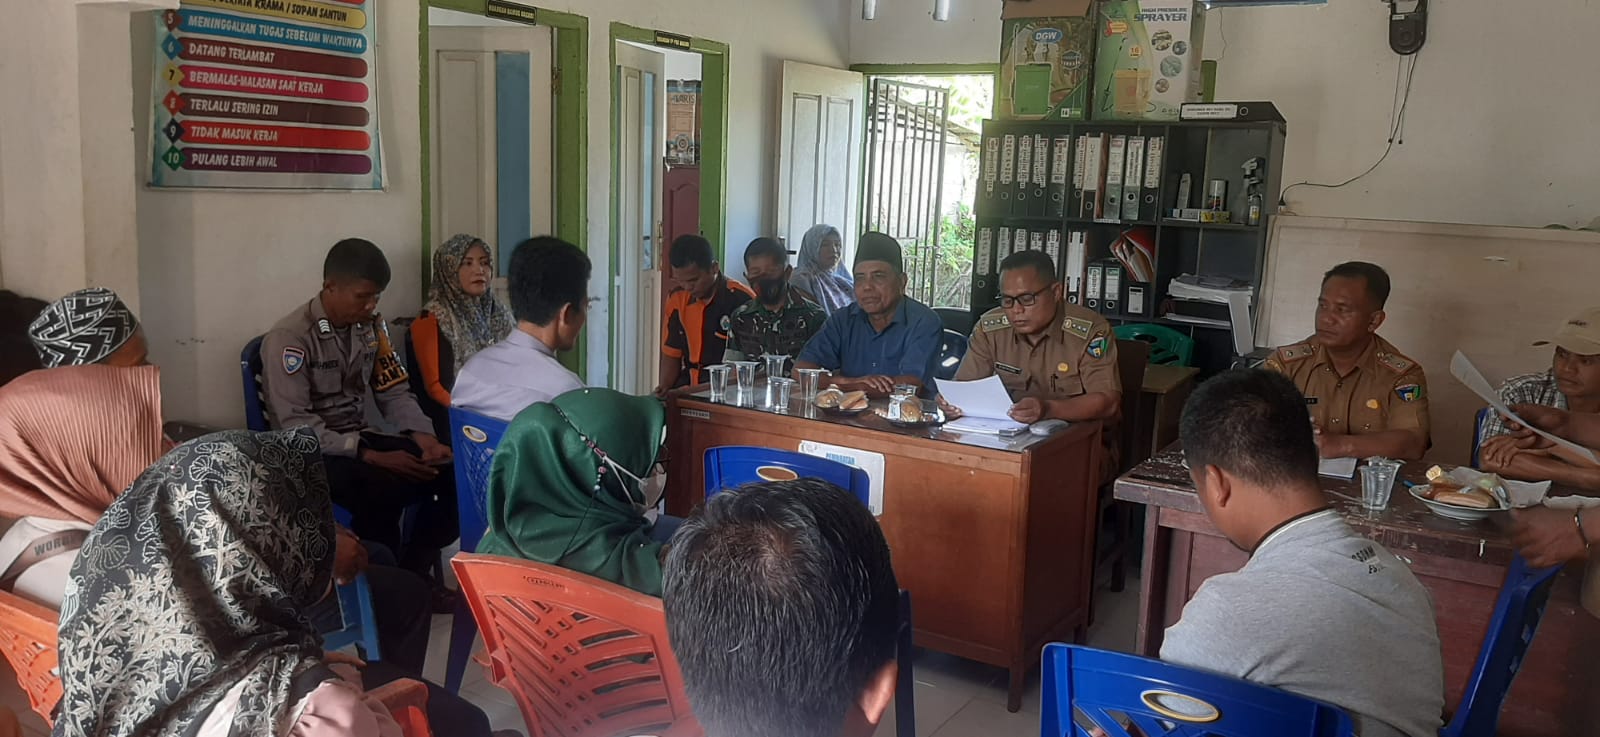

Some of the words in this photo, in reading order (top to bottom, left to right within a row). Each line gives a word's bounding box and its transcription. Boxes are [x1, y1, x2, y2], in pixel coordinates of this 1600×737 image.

[255, 0, 284, 12] KRAMA
[291, 4, 318, 17] SOPAN
[319, 8, 347, 21] SANTUN
[1133, 13, 1188, 22] SPRAYER
[167, 12, 174, 24] 5
[188, 15, 257, 34] MENINGGALKAN
[259, 24, 284, 39] TUGAS
[286, 29, 321, 42] SEBELUM
[322, 33, 362, 48] WAKTUNYA
[1035, 31, 1058, 40] DGW
[168, 42, 174, 51] 6
[188, 42, 227, 57] DATANG
[228, 47, 276, 63] TERLAMBAT
[168, 70, 175, 80] 7
[189, 71, 278, 90] BERMALAS-MALASAN
[278, 79, 298, 92] SAAT
[298, 80, 324, 94] KERJA
[190, 98, 230, 113] TERLALU
[231, 100, 261, 114] SERING
[262, 101, 279, 116] IZIN
[170, 125, 176, 137] 9
[190, 126, 220, 139] TIDAK
[224, 127, 252, 140] MASUK
[253, 128, 279, 141] KERJA
[168, 152, 180, 163] 10
[191, 154, 229, 166] PULANG
[231, 155, 255, 167] LEBIH
[256, 156, 278, 168] AWAL
